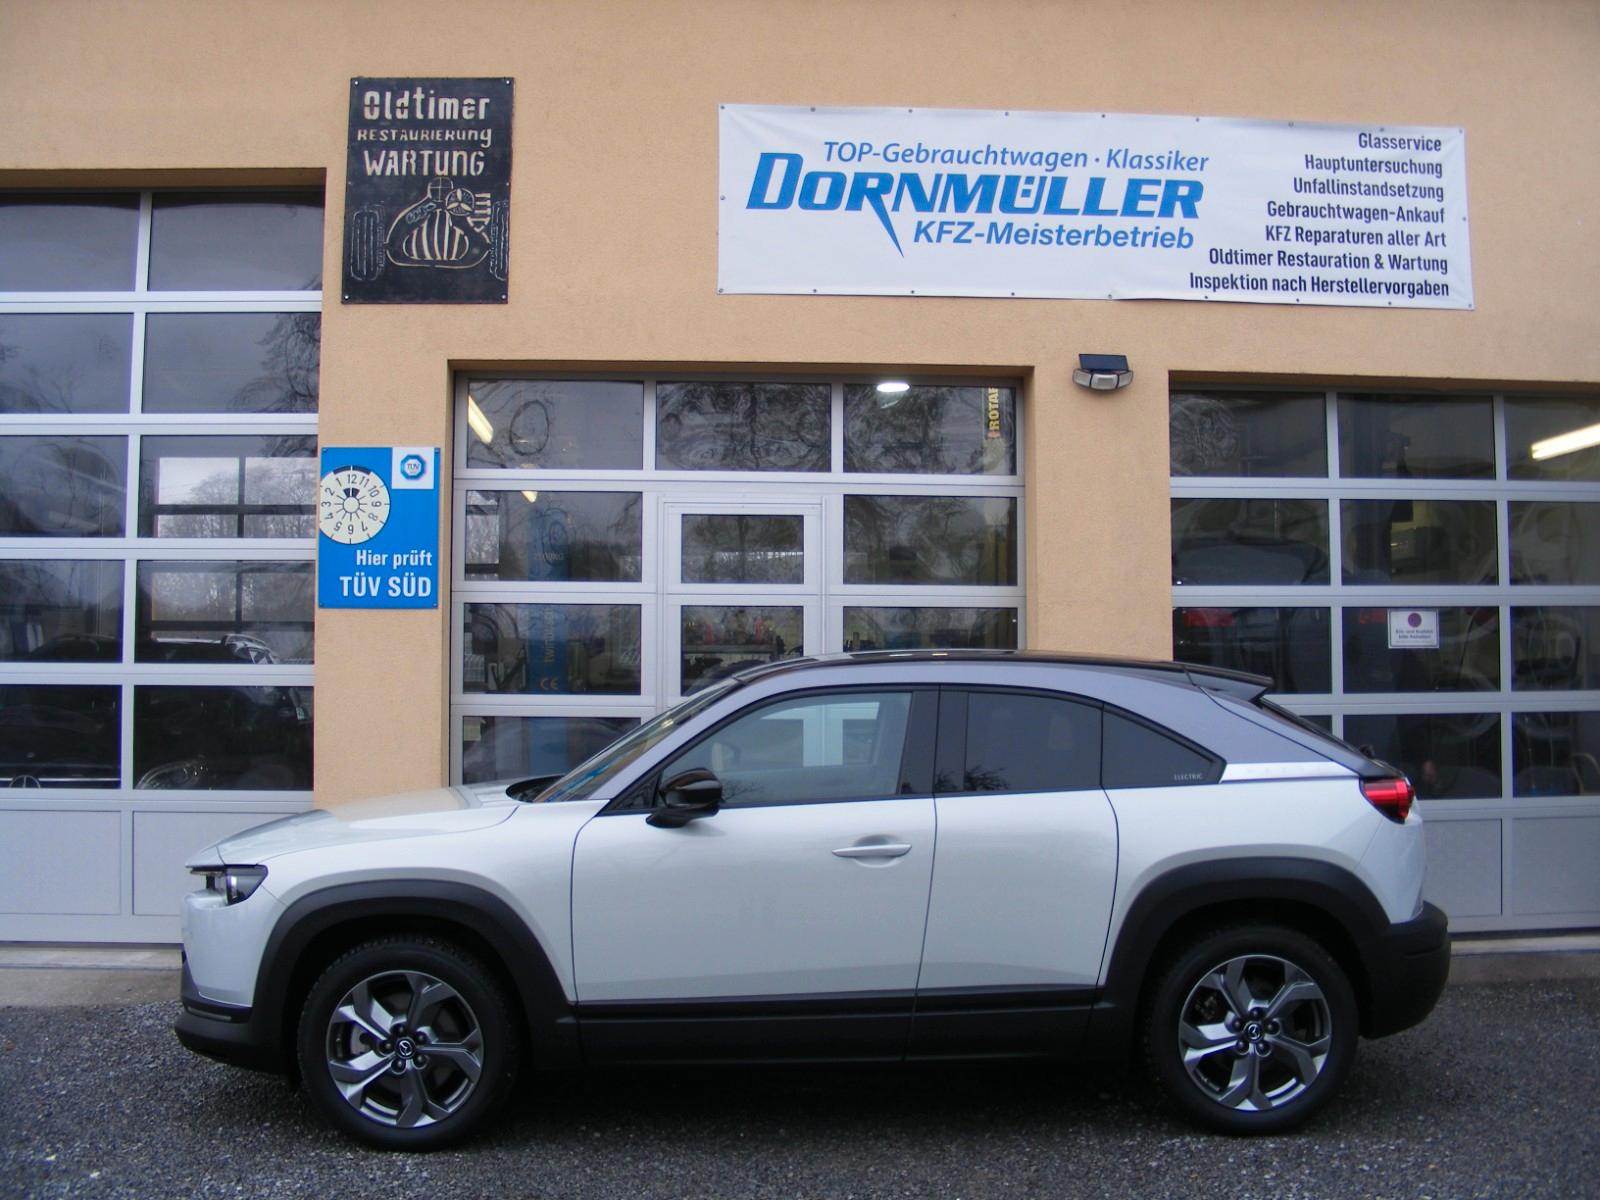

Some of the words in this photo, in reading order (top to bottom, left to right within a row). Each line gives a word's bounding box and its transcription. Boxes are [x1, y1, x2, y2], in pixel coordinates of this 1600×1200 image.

[363, 86, 490, 120] Oldtimer
[1358, 132, 1442, 152] Glasservice
[363, 150, 486, 177] WARTUNG
[824, 141, 1088, 172] TOP-Gebrauchtwagen
[1106, 148, 1209, 172] Klassiker
[1304, 154, 1443, 179] Hauptuntersuchung
[1293, 177, 1444, 202] Unfallinstandsetzung
[1267, 200, 1446, 224] Gebrauchtwagen-Ankauf
[913, 220, 1194, 249] KFZ-Meisterbetrieb
[1265, 225, 1291, 242] KFZ
[1294, 227, 1383, 246] Reparaturen
[1387, 230, 1420, 246] aller
[1424, 231, 1447, 248] Art
[1208, 248, 1274, 266] Oldtimer
[1277, 251, 1371, 269] Restauration
[1374, 253, 1385, 270] &
[1388, 254, 1448, 275] Wartung
[1189, 272, 1268, 292] Inspektion
[1272, 276, 1308, 291] nach
[1310, 276, 1449, 299] Herstellervorgaben
[347, 474, 357, 484] 12
[356, 550, 388, 566] Hier
[393, 550, 432, 569] prüft
[339, 572, 381, 597] TÜV
[388, 572, 432, 597] SÜD
